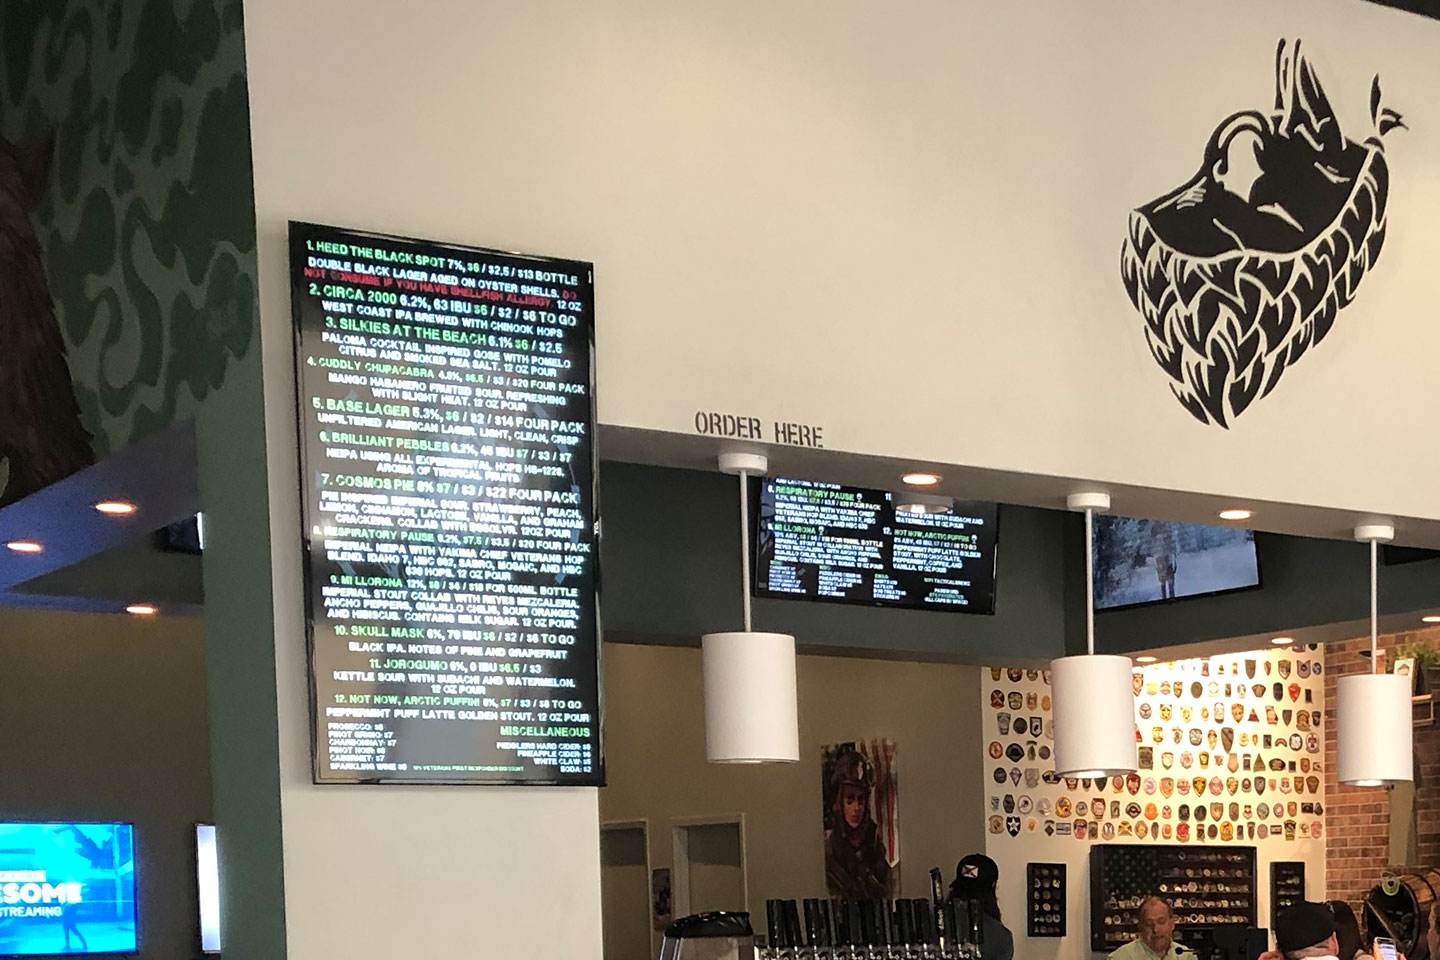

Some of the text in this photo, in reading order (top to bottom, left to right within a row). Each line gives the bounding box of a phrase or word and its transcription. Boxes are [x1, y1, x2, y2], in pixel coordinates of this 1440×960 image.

[308, 257, 559, 298] DOUBLE BLACK LAGER AGED ON OYSTER SHELLS.
[317, 242, 348, 255] HEED
[349, 246, 372, 258] THE
[375, 249, 414, 264] BLACK
[415, 255, 445, 268] SPOT
[489, 265, 509, 276] $2.5
[536, 271, 577, 285] BOTTLE
[309, 283, 576, 326] 2. CIRCA 2000 6.2%, 63 IBU $6 $2 $6 TO GO
[397, 280, 417, 291] YOU
[420, 283, 448, 295] HAVE
[557, 301, 567, 310] 12
[568, 302, 581, 312] OZ
[322, 301, 563, 337] WEST COAST IPA BREWED WITH CHINOOK HOPS
[326, 317, 562, 353] 3. SILKIES AT THE BEACH 6.1% $6 $2.5
[322, 332, 570, 368] PALOMA COCKTAIL INSPIRED GOSE WITH POMELO
[307, 357, 316, 366] 4.
[319, 358, 361, 370] CUDDLY
[365, 363, 434, 378] CHUPACABRA
[531, 380, 556, 391] FOUR
[559, 383, 585, 394] PACK
[312, 397, 324, 409] 5.
[327, 399, 363, 413] BASE
[366, 402, 410, 417] LAGER
[446, 410, 459, 422] $6
[495, 414, 514, 427] $14
[516, 416, 549, 430] FOUR
[551, 420, 584, 434] PACK
[694, 411, 824, 448] ORDER HERE
[332, 432, 393, 447] BRILLIANT
[396, 438, 449, 452] PEBBLES
[560, 453, 571, 462] $7
[321, 473, 577, 503] 7. COSMOS PIE FOUR PACK
[324, 526, 590, 552] RESPIRATORY PAUSE FOUR PACK
[355, 577, 402, 588] LLORONA
[486, 584, 505, 593] FOR
[540, 586, 578, 597] BOTTLE
[351, 626, 388, 637] SKULL
[391, 627, 424, 638] MASK
[505, 632, 516, 642] $2
[541, 634, 556, 643] TO
[558, 635, 574, 644] GO
[384, 659, 541, 674] JOROGUMO $3
[350, 695, 370, 704] NOT
[404, 696, 440, 705] ARCTIC
[552, 701, 565, 709] TO
[568, 701, 581, 709] GO
[422, 710, 455, 720] LATTE
[564, 713, 589, 722] POUR
[500, 726, 590, 737] MISCELLANEOUS
